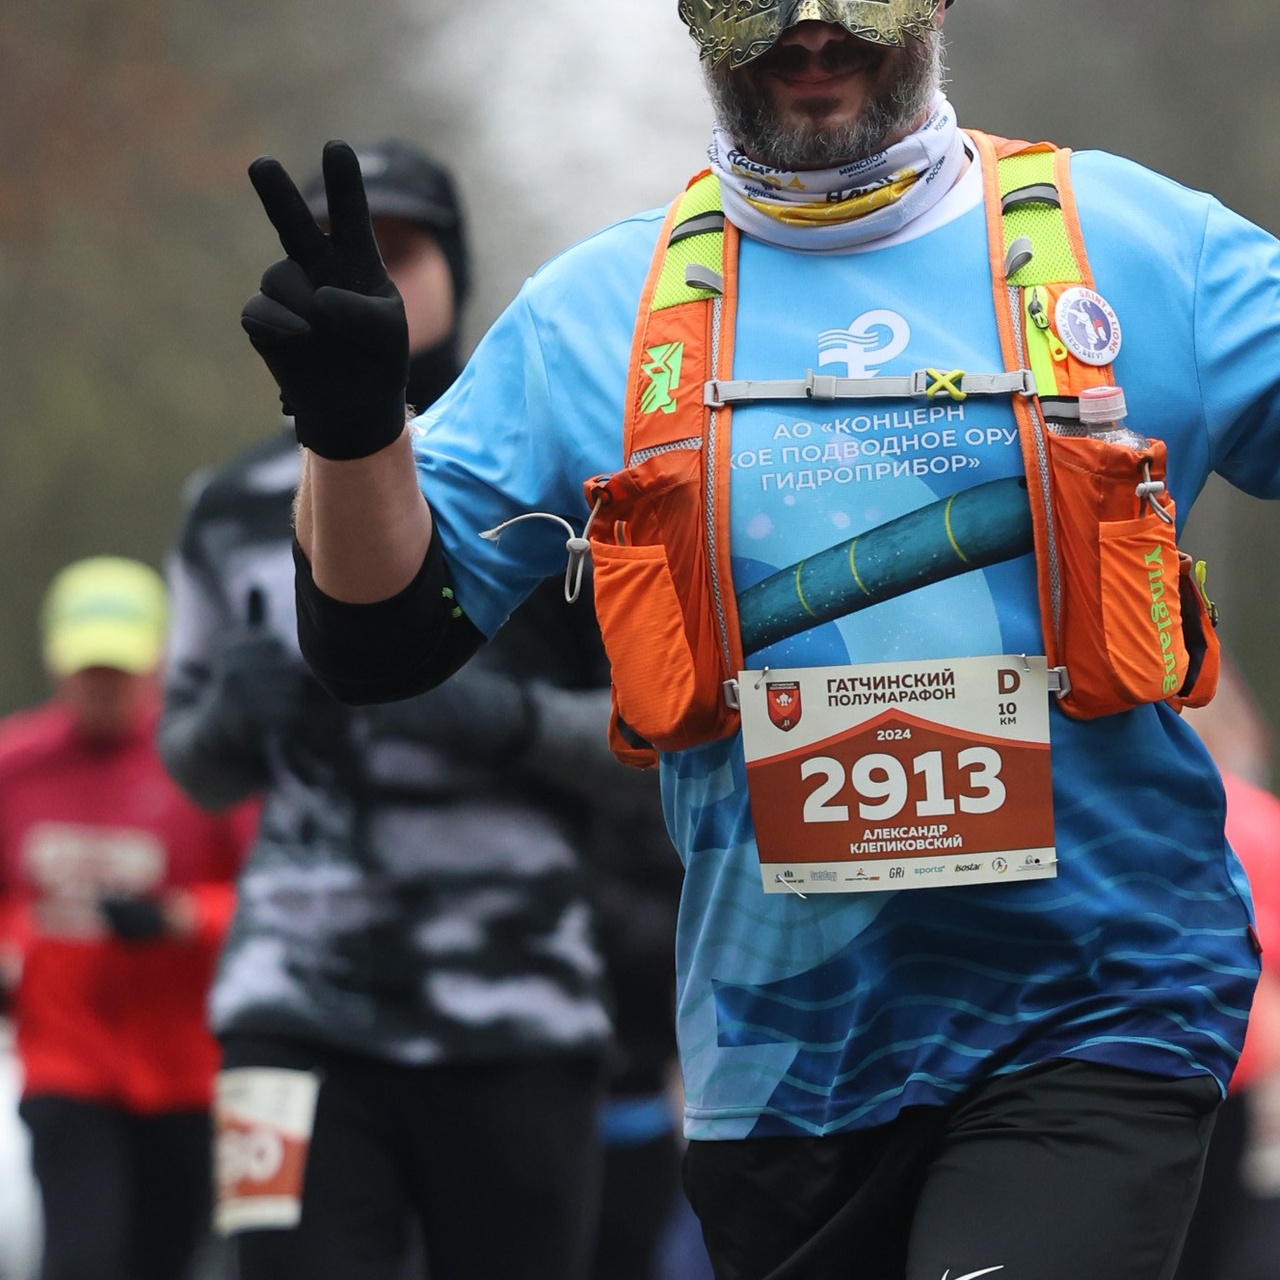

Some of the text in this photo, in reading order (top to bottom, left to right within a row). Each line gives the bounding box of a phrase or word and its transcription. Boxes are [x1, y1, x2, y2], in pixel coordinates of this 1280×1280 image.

[773, 405, 965, 440] АО «КОНЦЕРН
[782, 429, 957, 464] ПОДВОДНОЕ
[761, 455, 981, 491] ГИДРОПРИБОР»
[1144, 544, 1179, 695] Yinglang
[826, 668, 955, 693] ГАТЧИНСКИЙ
[997, 669, 1021, 695] D
[828, 687, 956, 707] ПОЛУМАРАФОН
[998, 702, 1017, 715] 10
[1000, 717, 1017, 726] КМ
[877, 728, 912, 741] 2024
[800, 746, 1007, 823] 2913
[849, 834, 963, 855] КЛЕПИКОВСКИЙ
[862, 825, 949, 840] АЛЕКСАНДР
